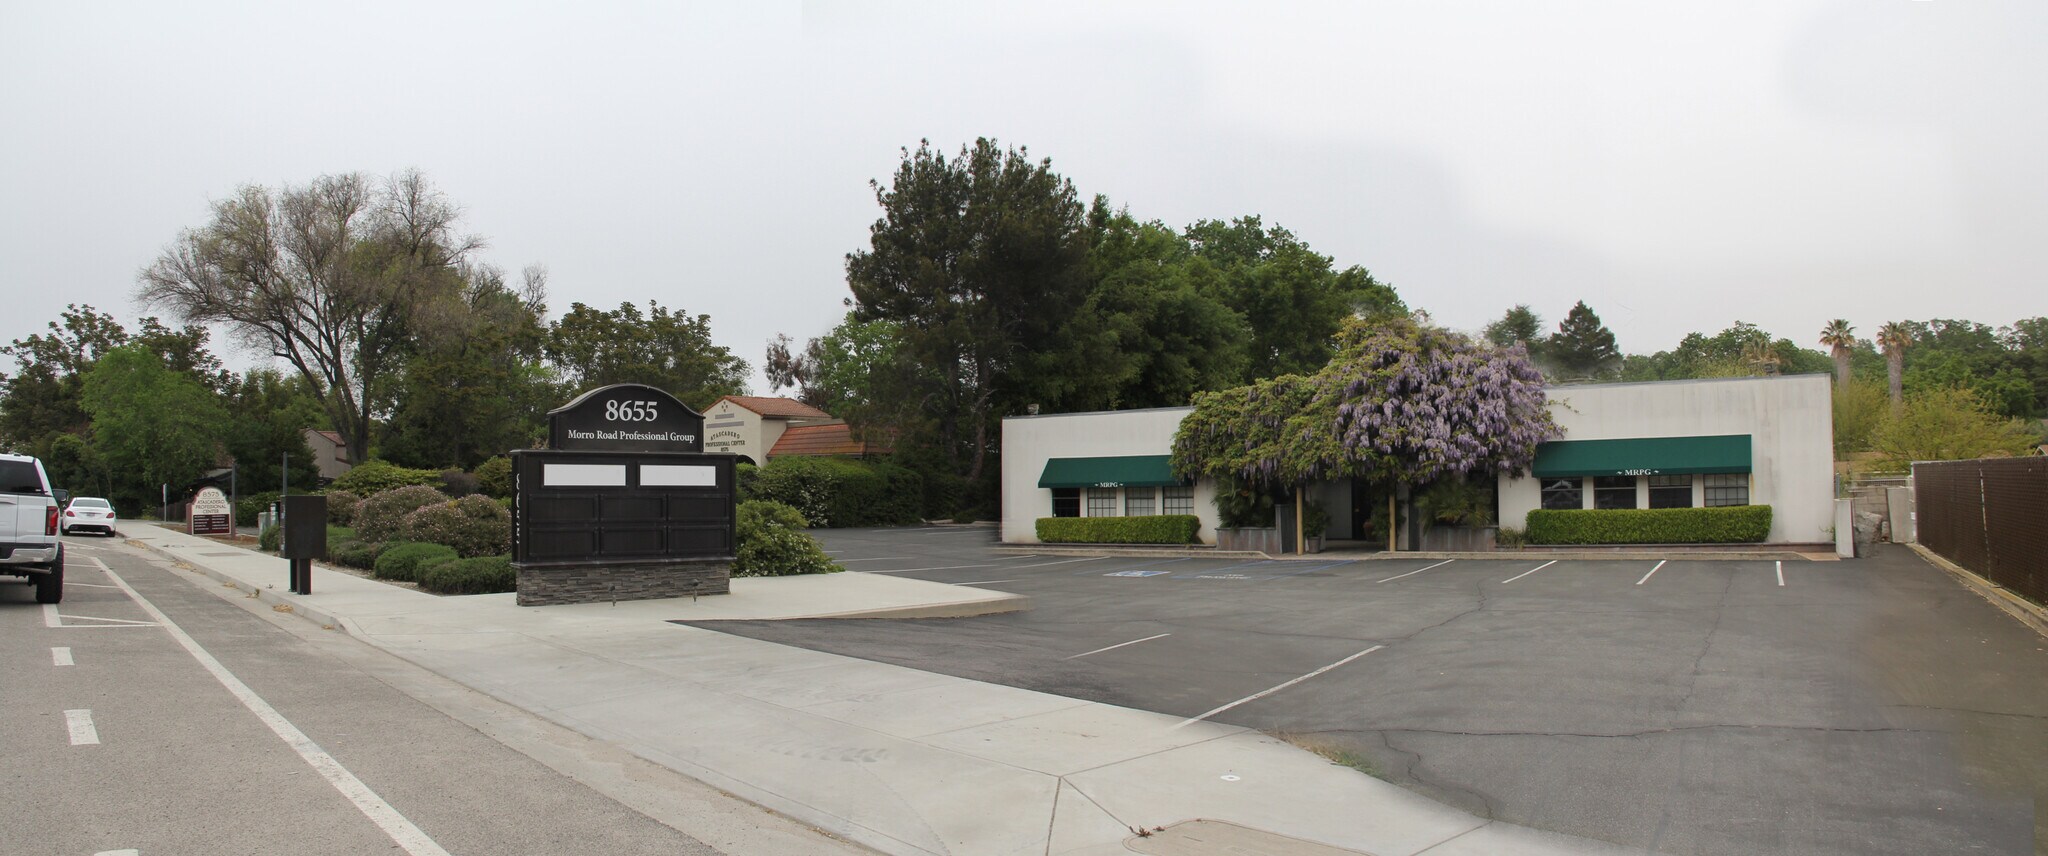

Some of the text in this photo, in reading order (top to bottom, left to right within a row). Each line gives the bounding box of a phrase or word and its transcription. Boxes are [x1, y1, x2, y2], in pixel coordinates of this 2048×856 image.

[605, 399, 658, 422] 8655
[568, 429, 695, 443] Morro Road Professional Group
